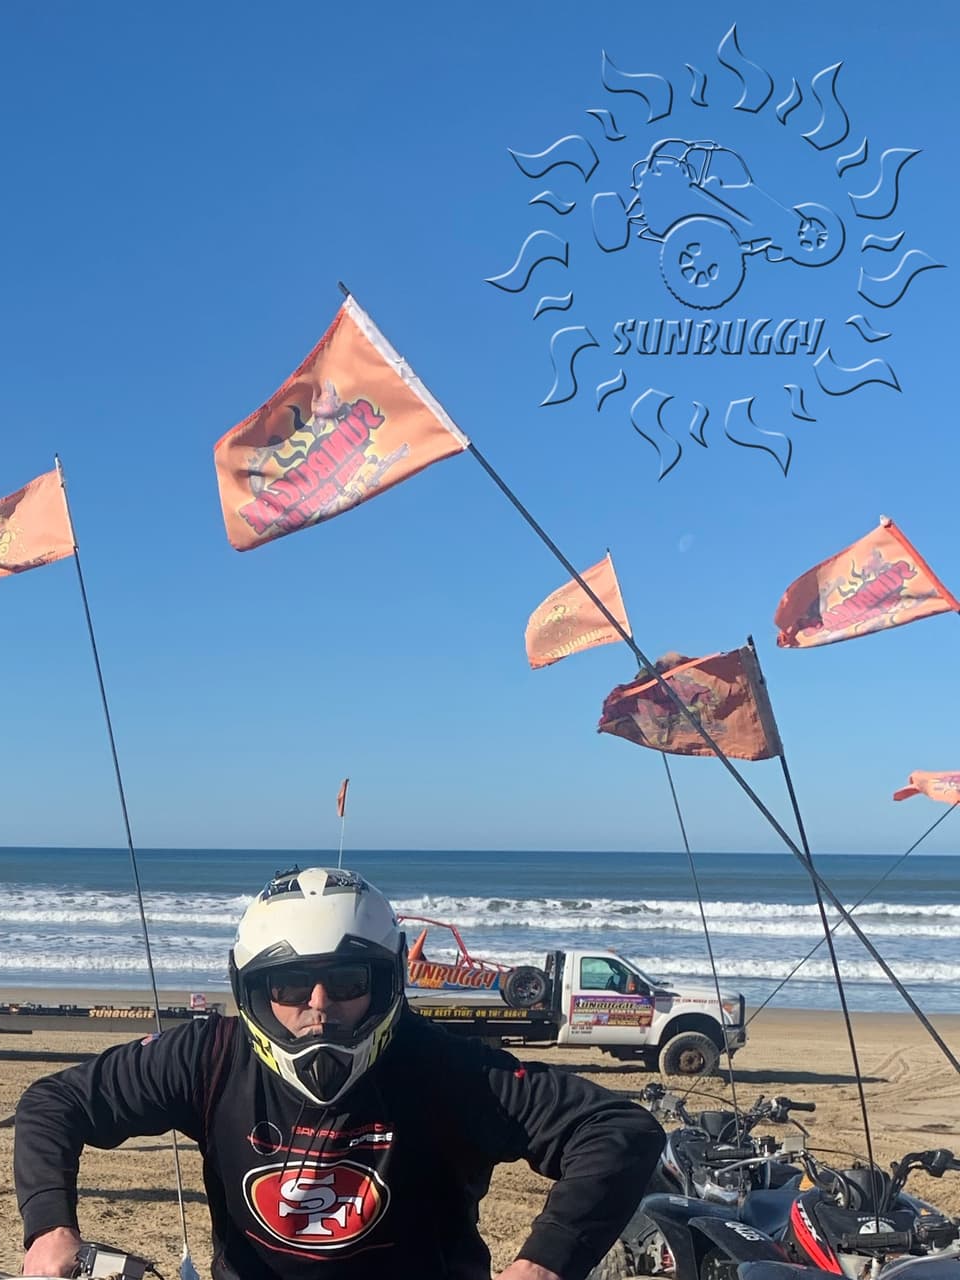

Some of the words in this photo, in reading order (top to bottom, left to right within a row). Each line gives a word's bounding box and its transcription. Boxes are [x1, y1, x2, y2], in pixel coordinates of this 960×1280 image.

[407, 961, 497, 990] UNBUGGY
[88, 1008, 156, 1019] SUNBUGGIE
[278, 1174, 363, 1236] SF
